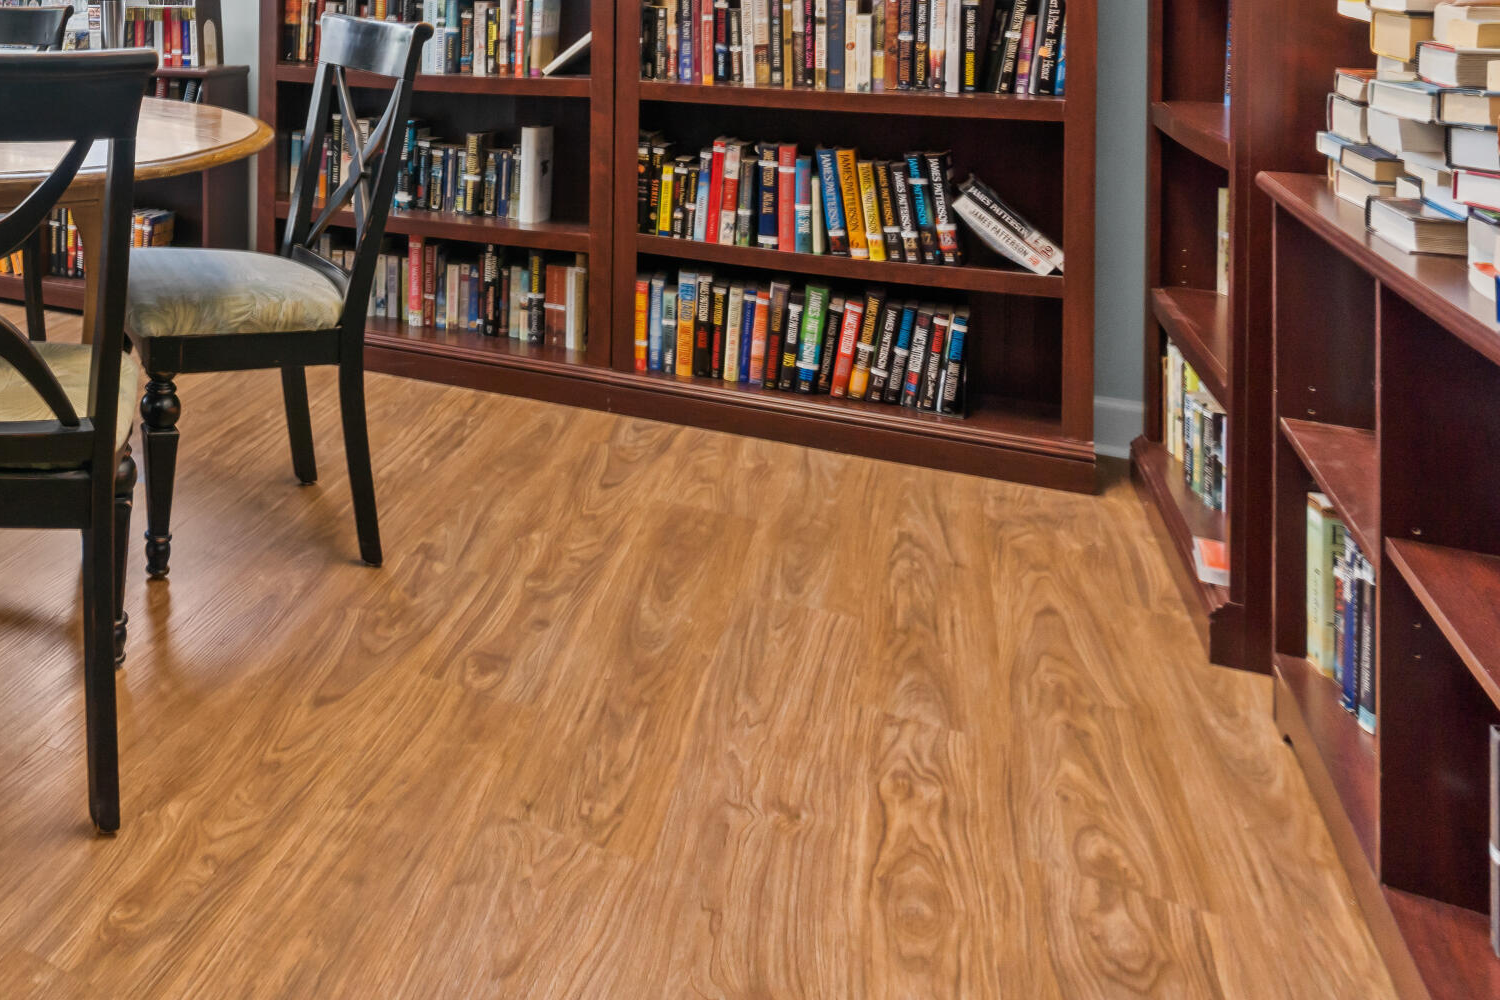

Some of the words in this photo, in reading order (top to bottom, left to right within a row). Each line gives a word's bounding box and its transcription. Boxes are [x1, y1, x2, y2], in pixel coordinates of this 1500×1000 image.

[965, 8, 976, 24] SARA
[1046, 14, 1059, 34] Parker
[1040, 59, 1053, 81] Honor
[820, 154, 832, 180] JAMES
[840, 153, 854, 180] JAMES
[859, 165, 872, 189] JAMES
[877, 165, 888, 186] JAMES
[927, 158, 941, 182] JAMES
[893, 171, 906, 193] JAMES
[823, 180, 841, 230] PATTERSON
[844, 180, 860, 232] PATTERSON
[863, 191, 878, 236] PATTERSON
[880, 187, 894, 227] PATTERSON
[898, 193, 913, 233] PATTERSON
[912, 183, 928, 226] PATTERSON
[933, 183, 950, 226] PATTERSON
[809, 291, 823, 317] JAMES
[867, 297, 880, 316] JAMES
[885, 309, 898, 332] JAMES
[803, 319, 822, 366] PATTERSON
[877, 331, 893, 370] PATTERSON
[783, 352, 796, 368] TOYS
